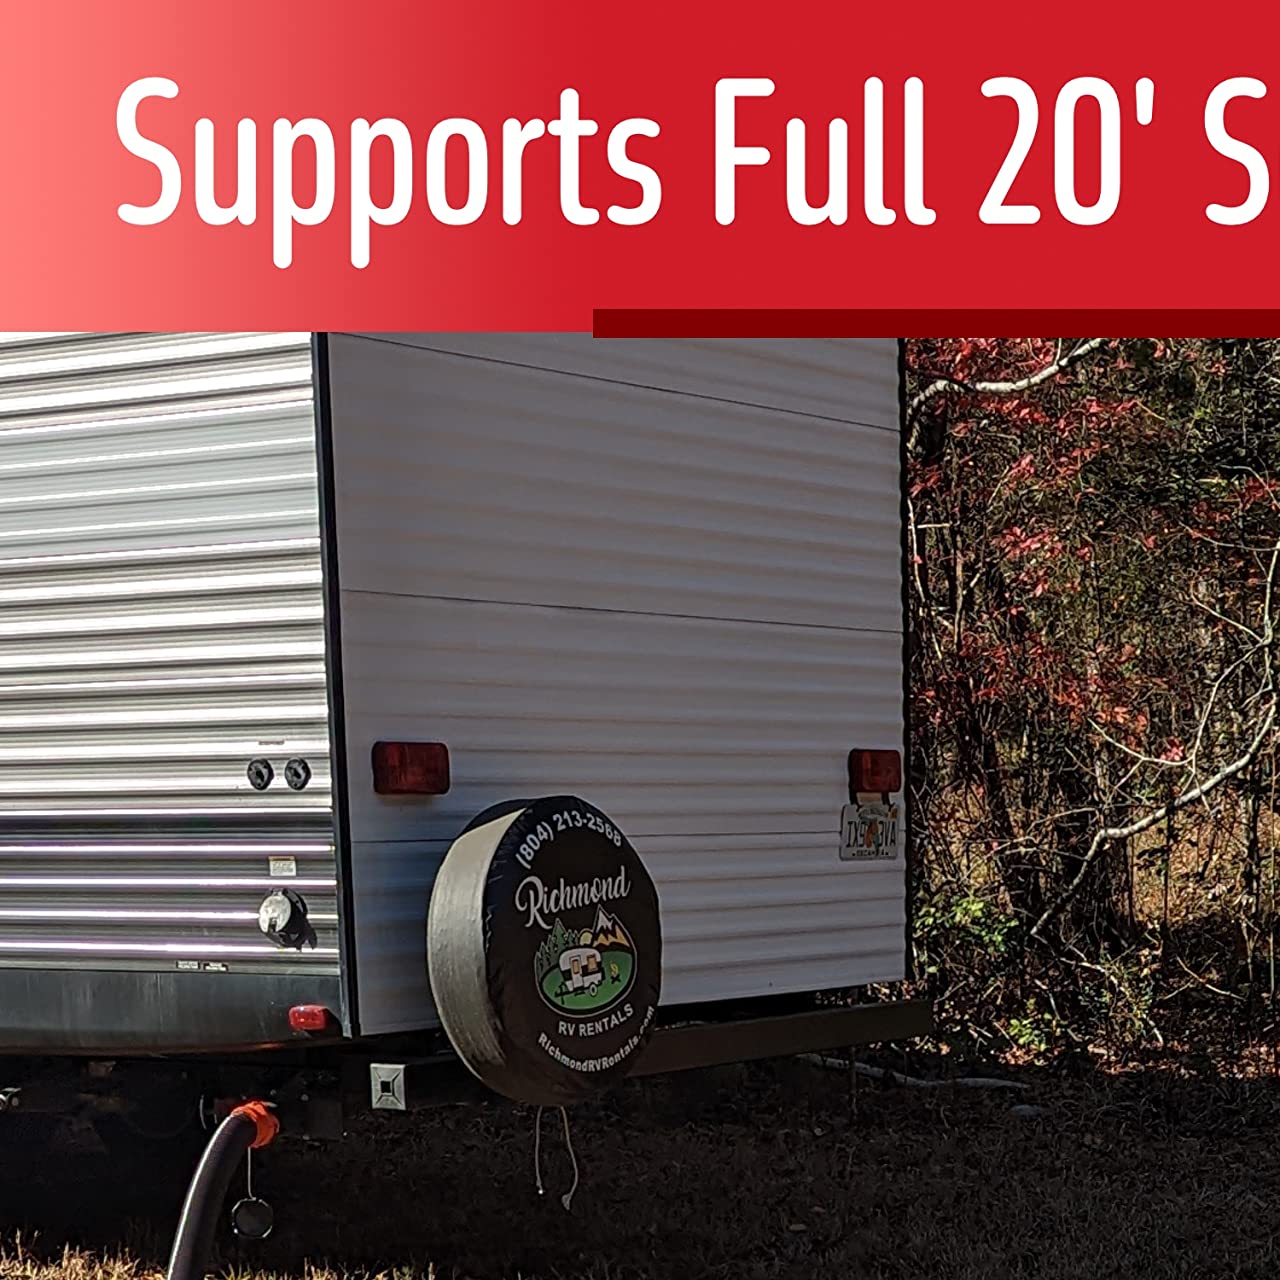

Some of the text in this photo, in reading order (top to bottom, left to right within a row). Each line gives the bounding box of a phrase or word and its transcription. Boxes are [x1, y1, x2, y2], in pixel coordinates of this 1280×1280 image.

[515, 821, 554, 869] (804)
[515, 865, 631, 930] Richmond
[558, 1003, 634, 1037] RV RENTALS
